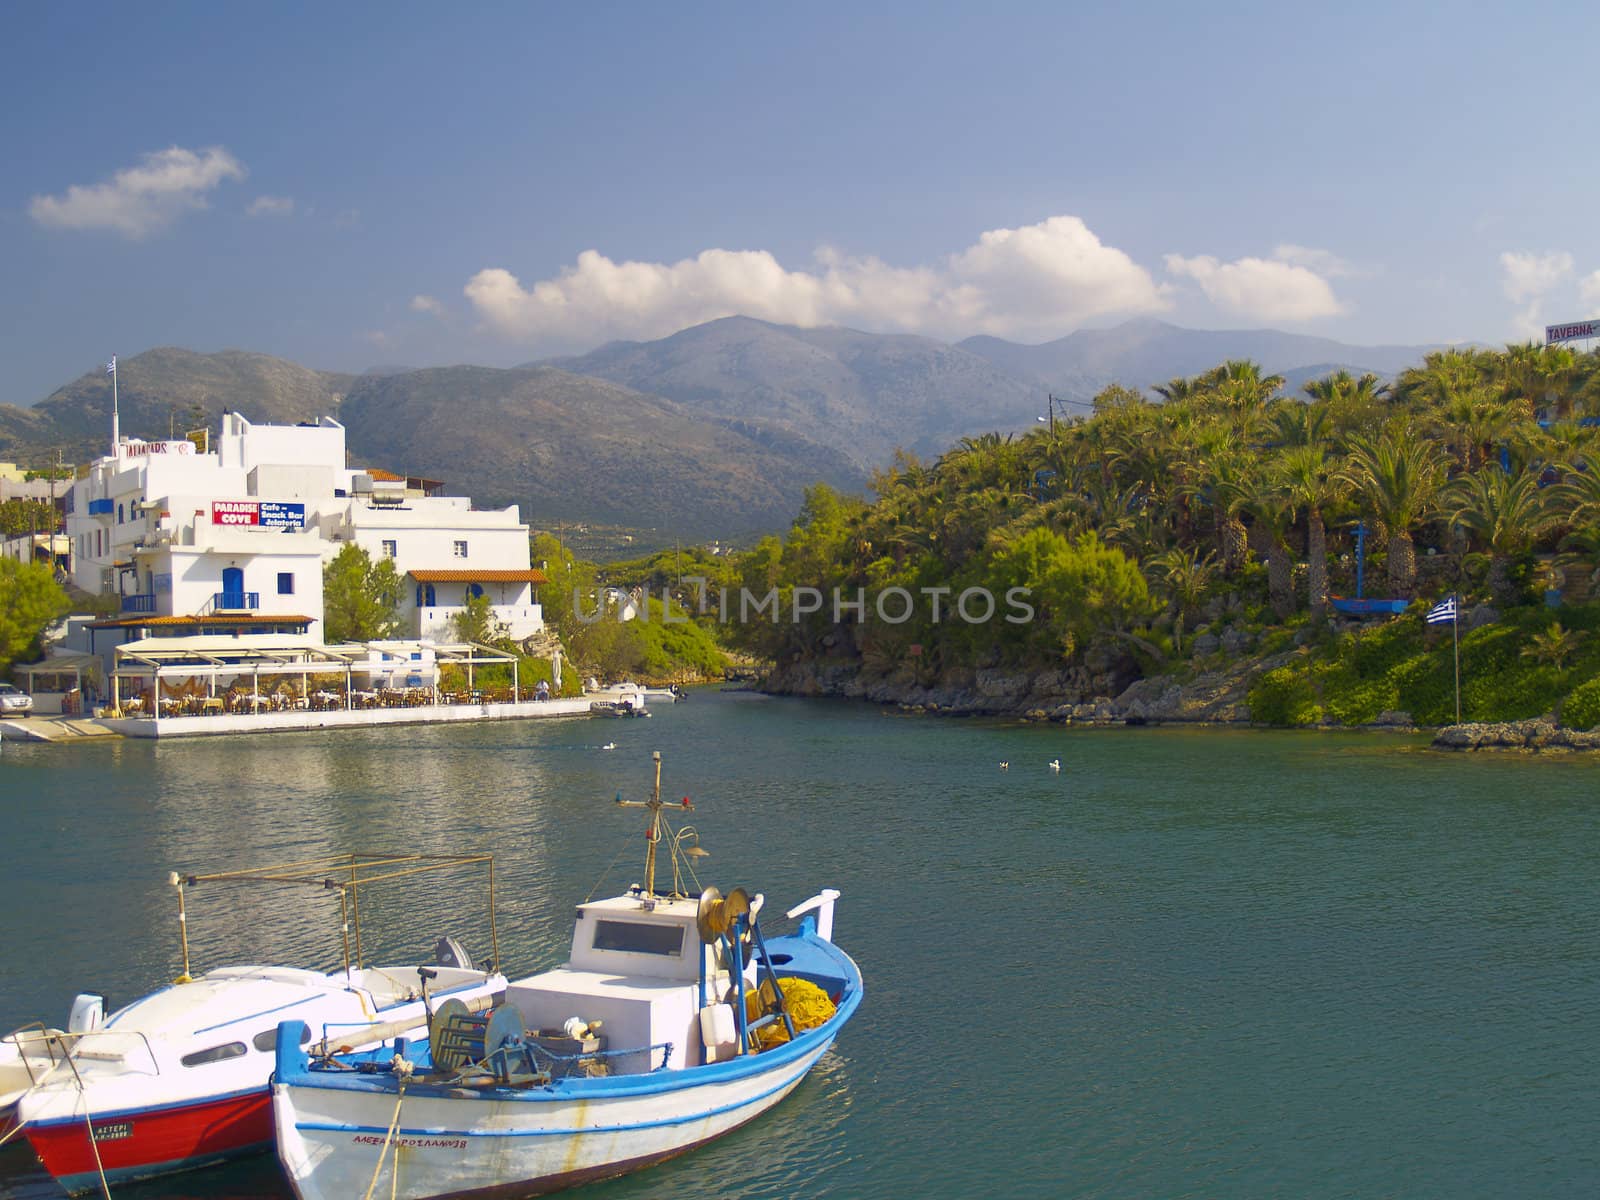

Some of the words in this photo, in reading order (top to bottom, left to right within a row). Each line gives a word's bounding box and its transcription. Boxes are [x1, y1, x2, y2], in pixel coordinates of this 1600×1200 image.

[1547, 324, 1593, 340] TAVERNA
[214, 503, 258, 513] PARADISE
[221, 514, 251, 524] COVE
[261, 511, 286, 519] Snack
